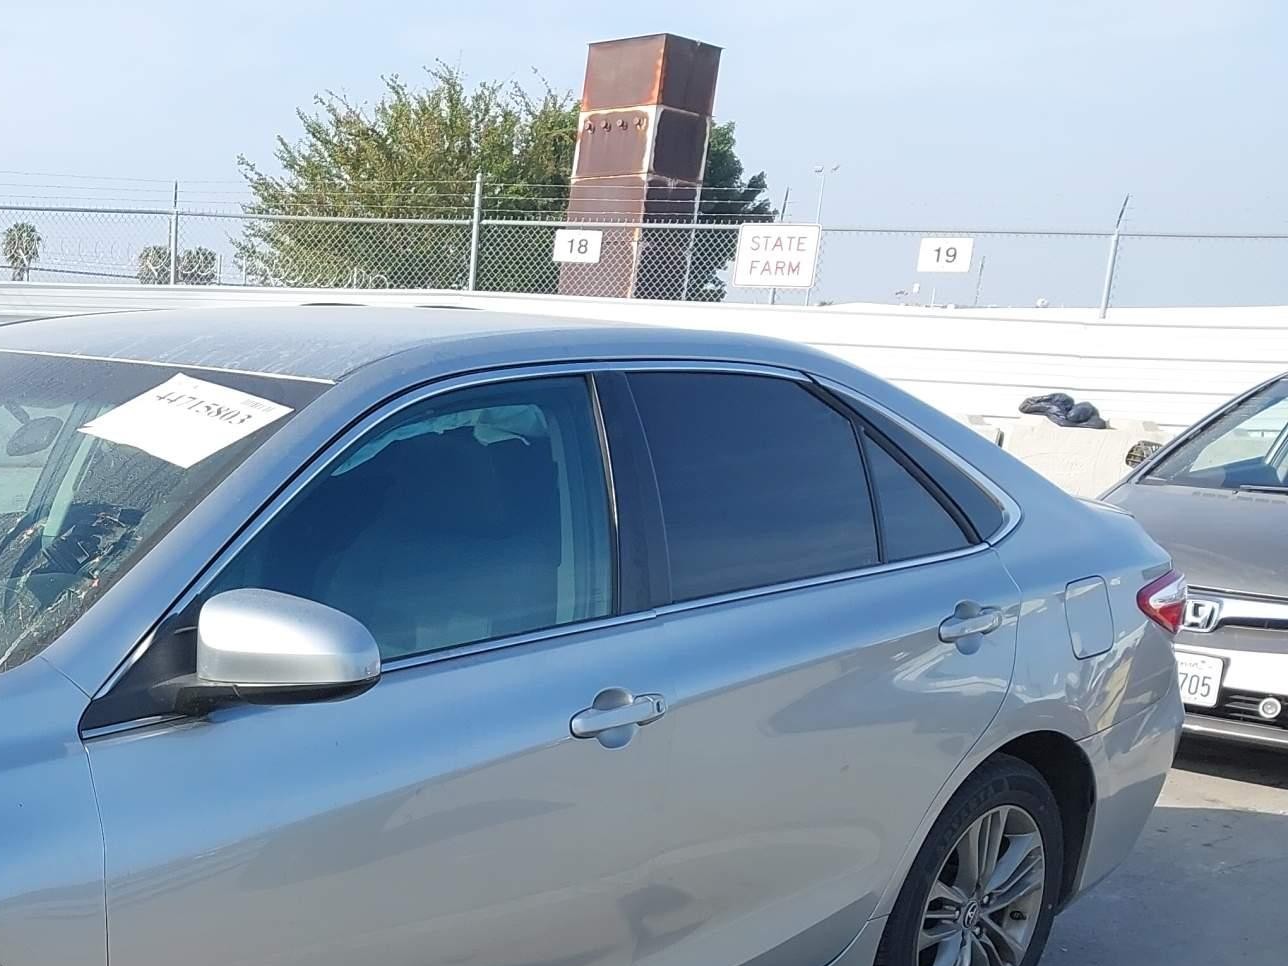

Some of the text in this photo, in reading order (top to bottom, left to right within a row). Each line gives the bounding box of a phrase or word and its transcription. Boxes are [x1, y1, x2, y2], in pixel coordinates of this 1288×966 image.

[567, 238, 588, 255] 18
[750, 235, 808, 253] STATE
[933, 246, 958, 264] 19
[749, 260, 801, 277] FARM
[156, 391, 253, 425] 44715803
